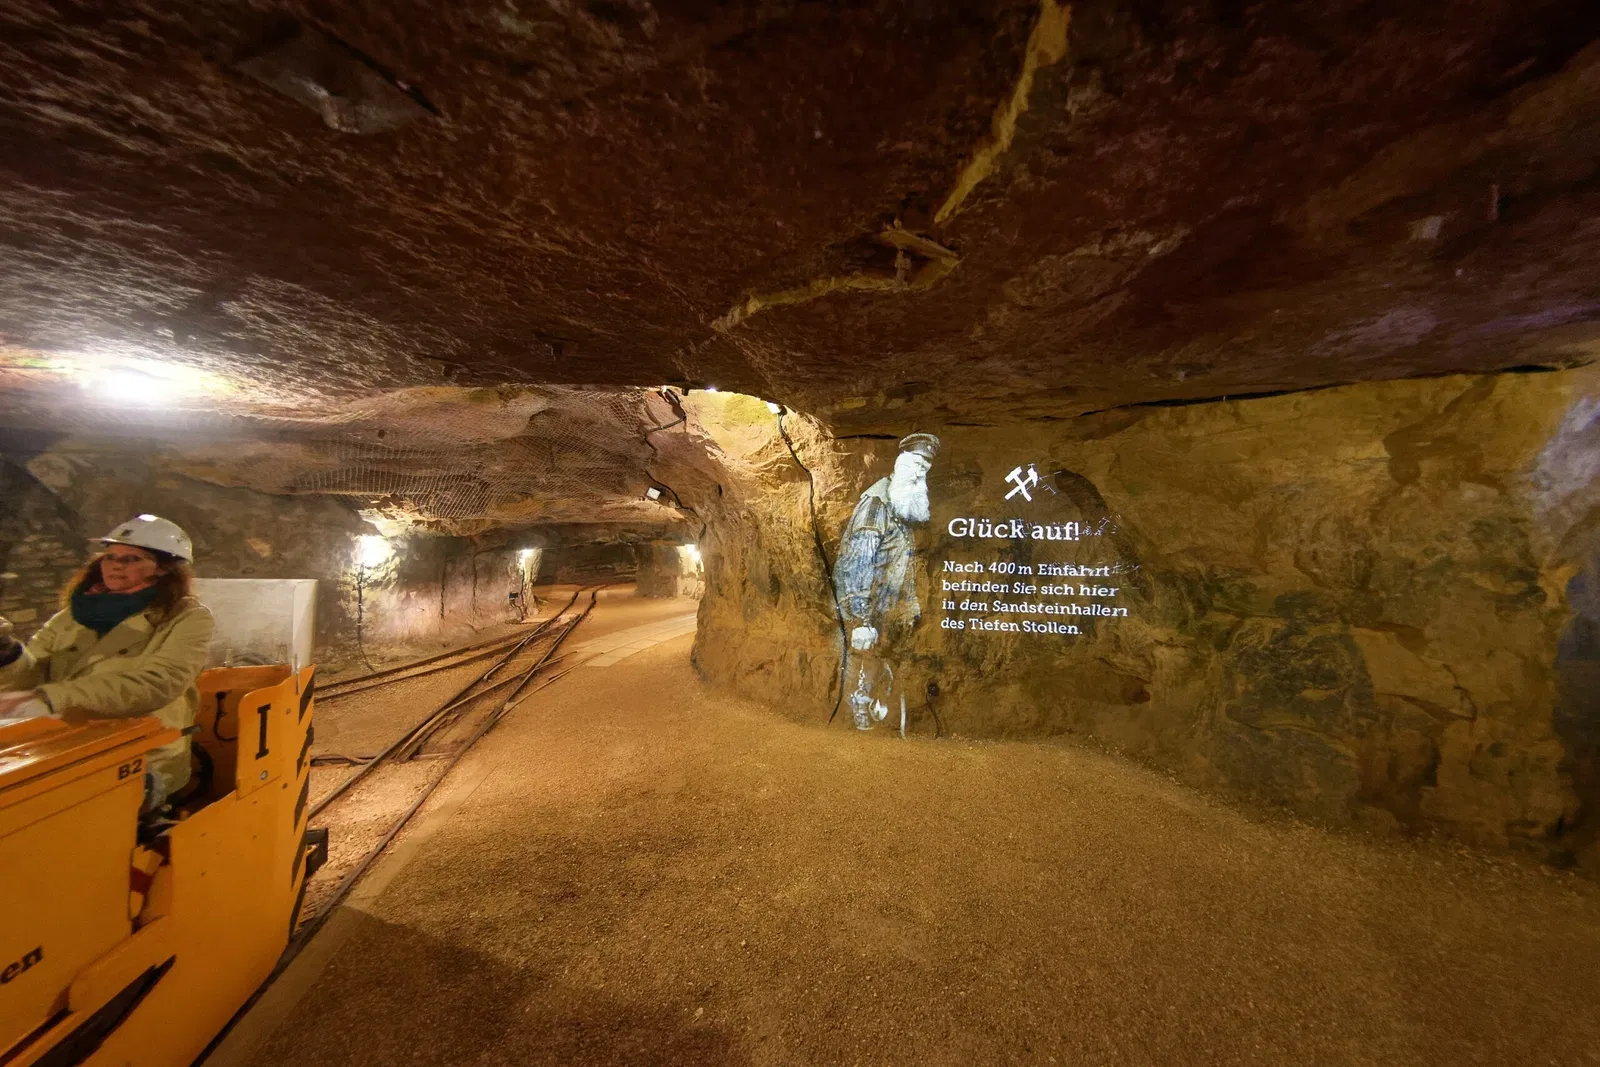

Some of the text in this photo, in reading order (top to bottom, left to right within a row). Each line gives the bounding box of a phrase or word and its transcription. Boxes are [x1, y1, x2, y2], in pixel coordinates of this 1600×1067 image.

[948, 518, 1080, 541] Glück auf!
[943, 561, 1110, 577] Nach 400 m Einfahrt
[942, 580, 1119, 597] befinden Sie sich hier
[942, 599, 1128, 617] in den Sandsteinhallen
[941, 617, 1083, 635] des Tiefen Stollen.
[118, 758, 143, 780] B2
